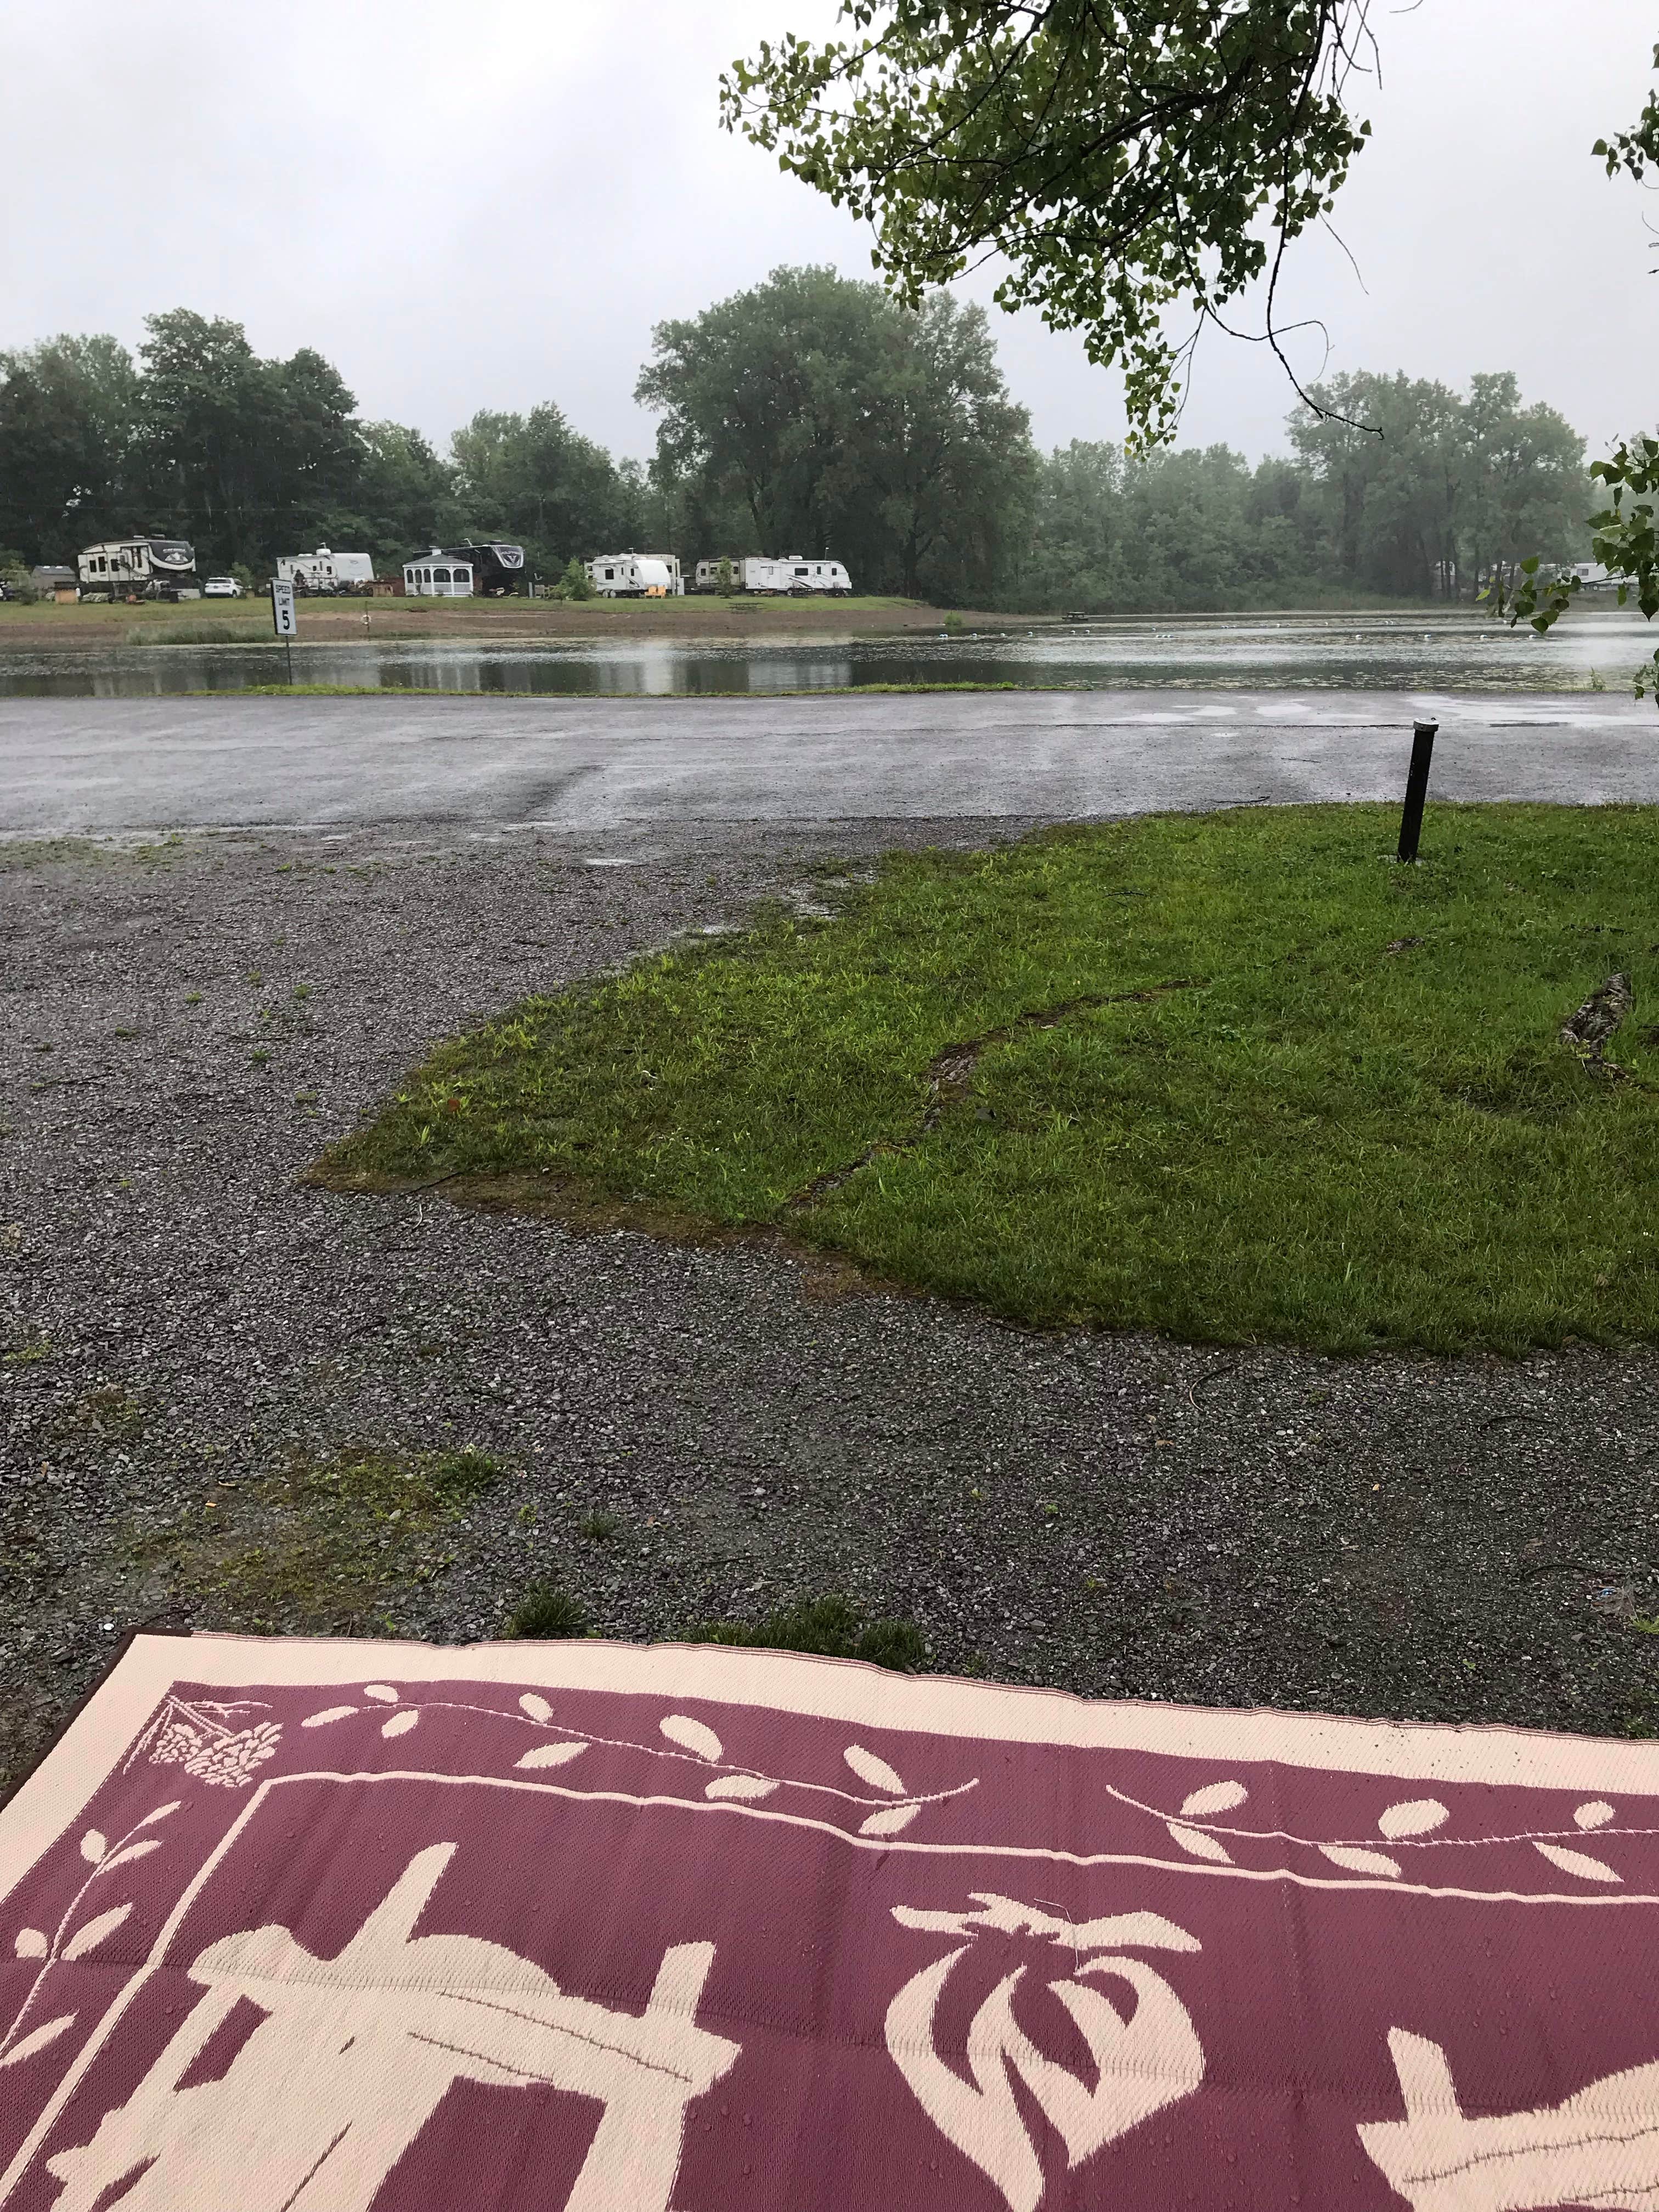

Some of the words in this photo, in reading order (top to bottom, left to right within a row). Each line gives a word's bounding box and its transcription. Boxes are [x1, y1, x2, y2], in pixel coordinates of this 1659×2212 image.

[275, 585, 290, 594] SPEED
[278, 597, 290, 606] LIMIT
[282, 610, 290, 630] 5
